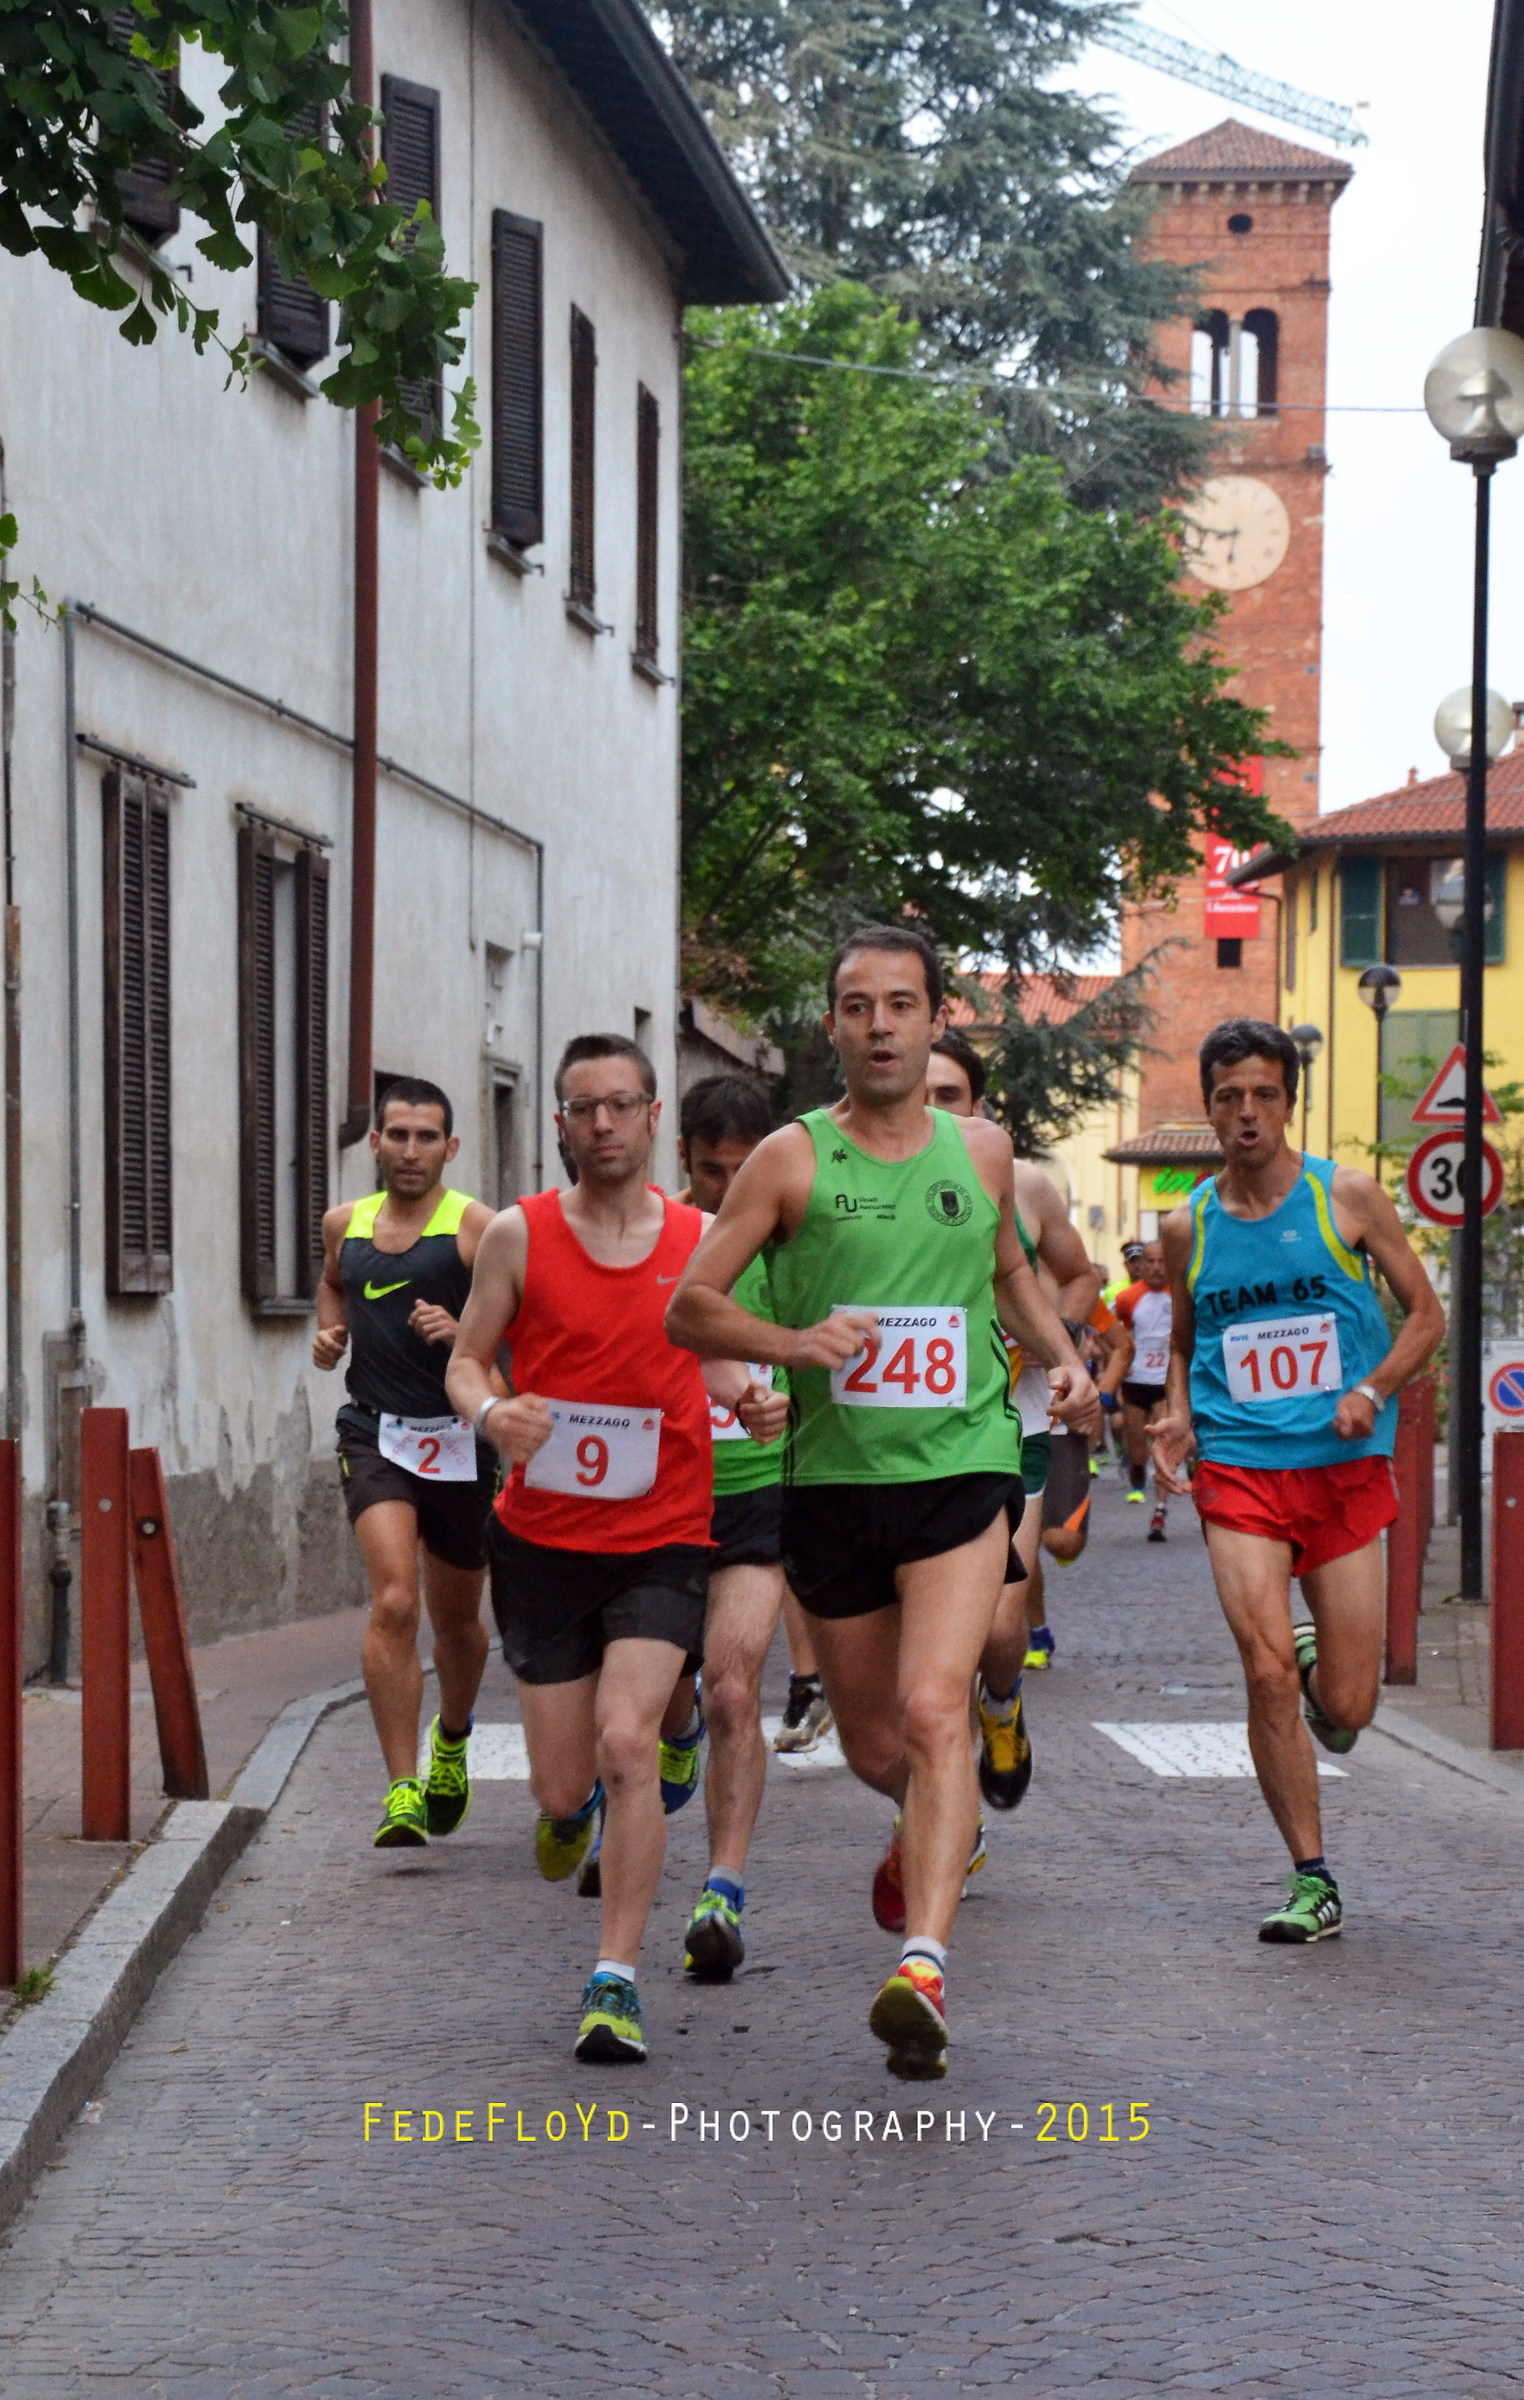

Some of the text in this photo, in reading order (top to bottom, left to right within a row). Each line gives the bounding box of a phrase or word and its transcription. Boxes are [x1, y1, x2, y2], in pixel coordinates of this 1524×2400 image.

[1205, 1274, 1327, 1317] TEAM 65
[877, 1317, 937, 1327] MEZZAGO
[1257, 1327, 1310, 1341] MEZZAGO
[844, 1337, 957, 1395] 248
[1145, 1352, 1166, 1368] 22
[1240, 1340, 1328, 1393] 107
[569, 1413, 631, 1428] MEZZAGO
[417, 1437, 441, 1474] 2
[576, 1434, 610, 1487] 9
